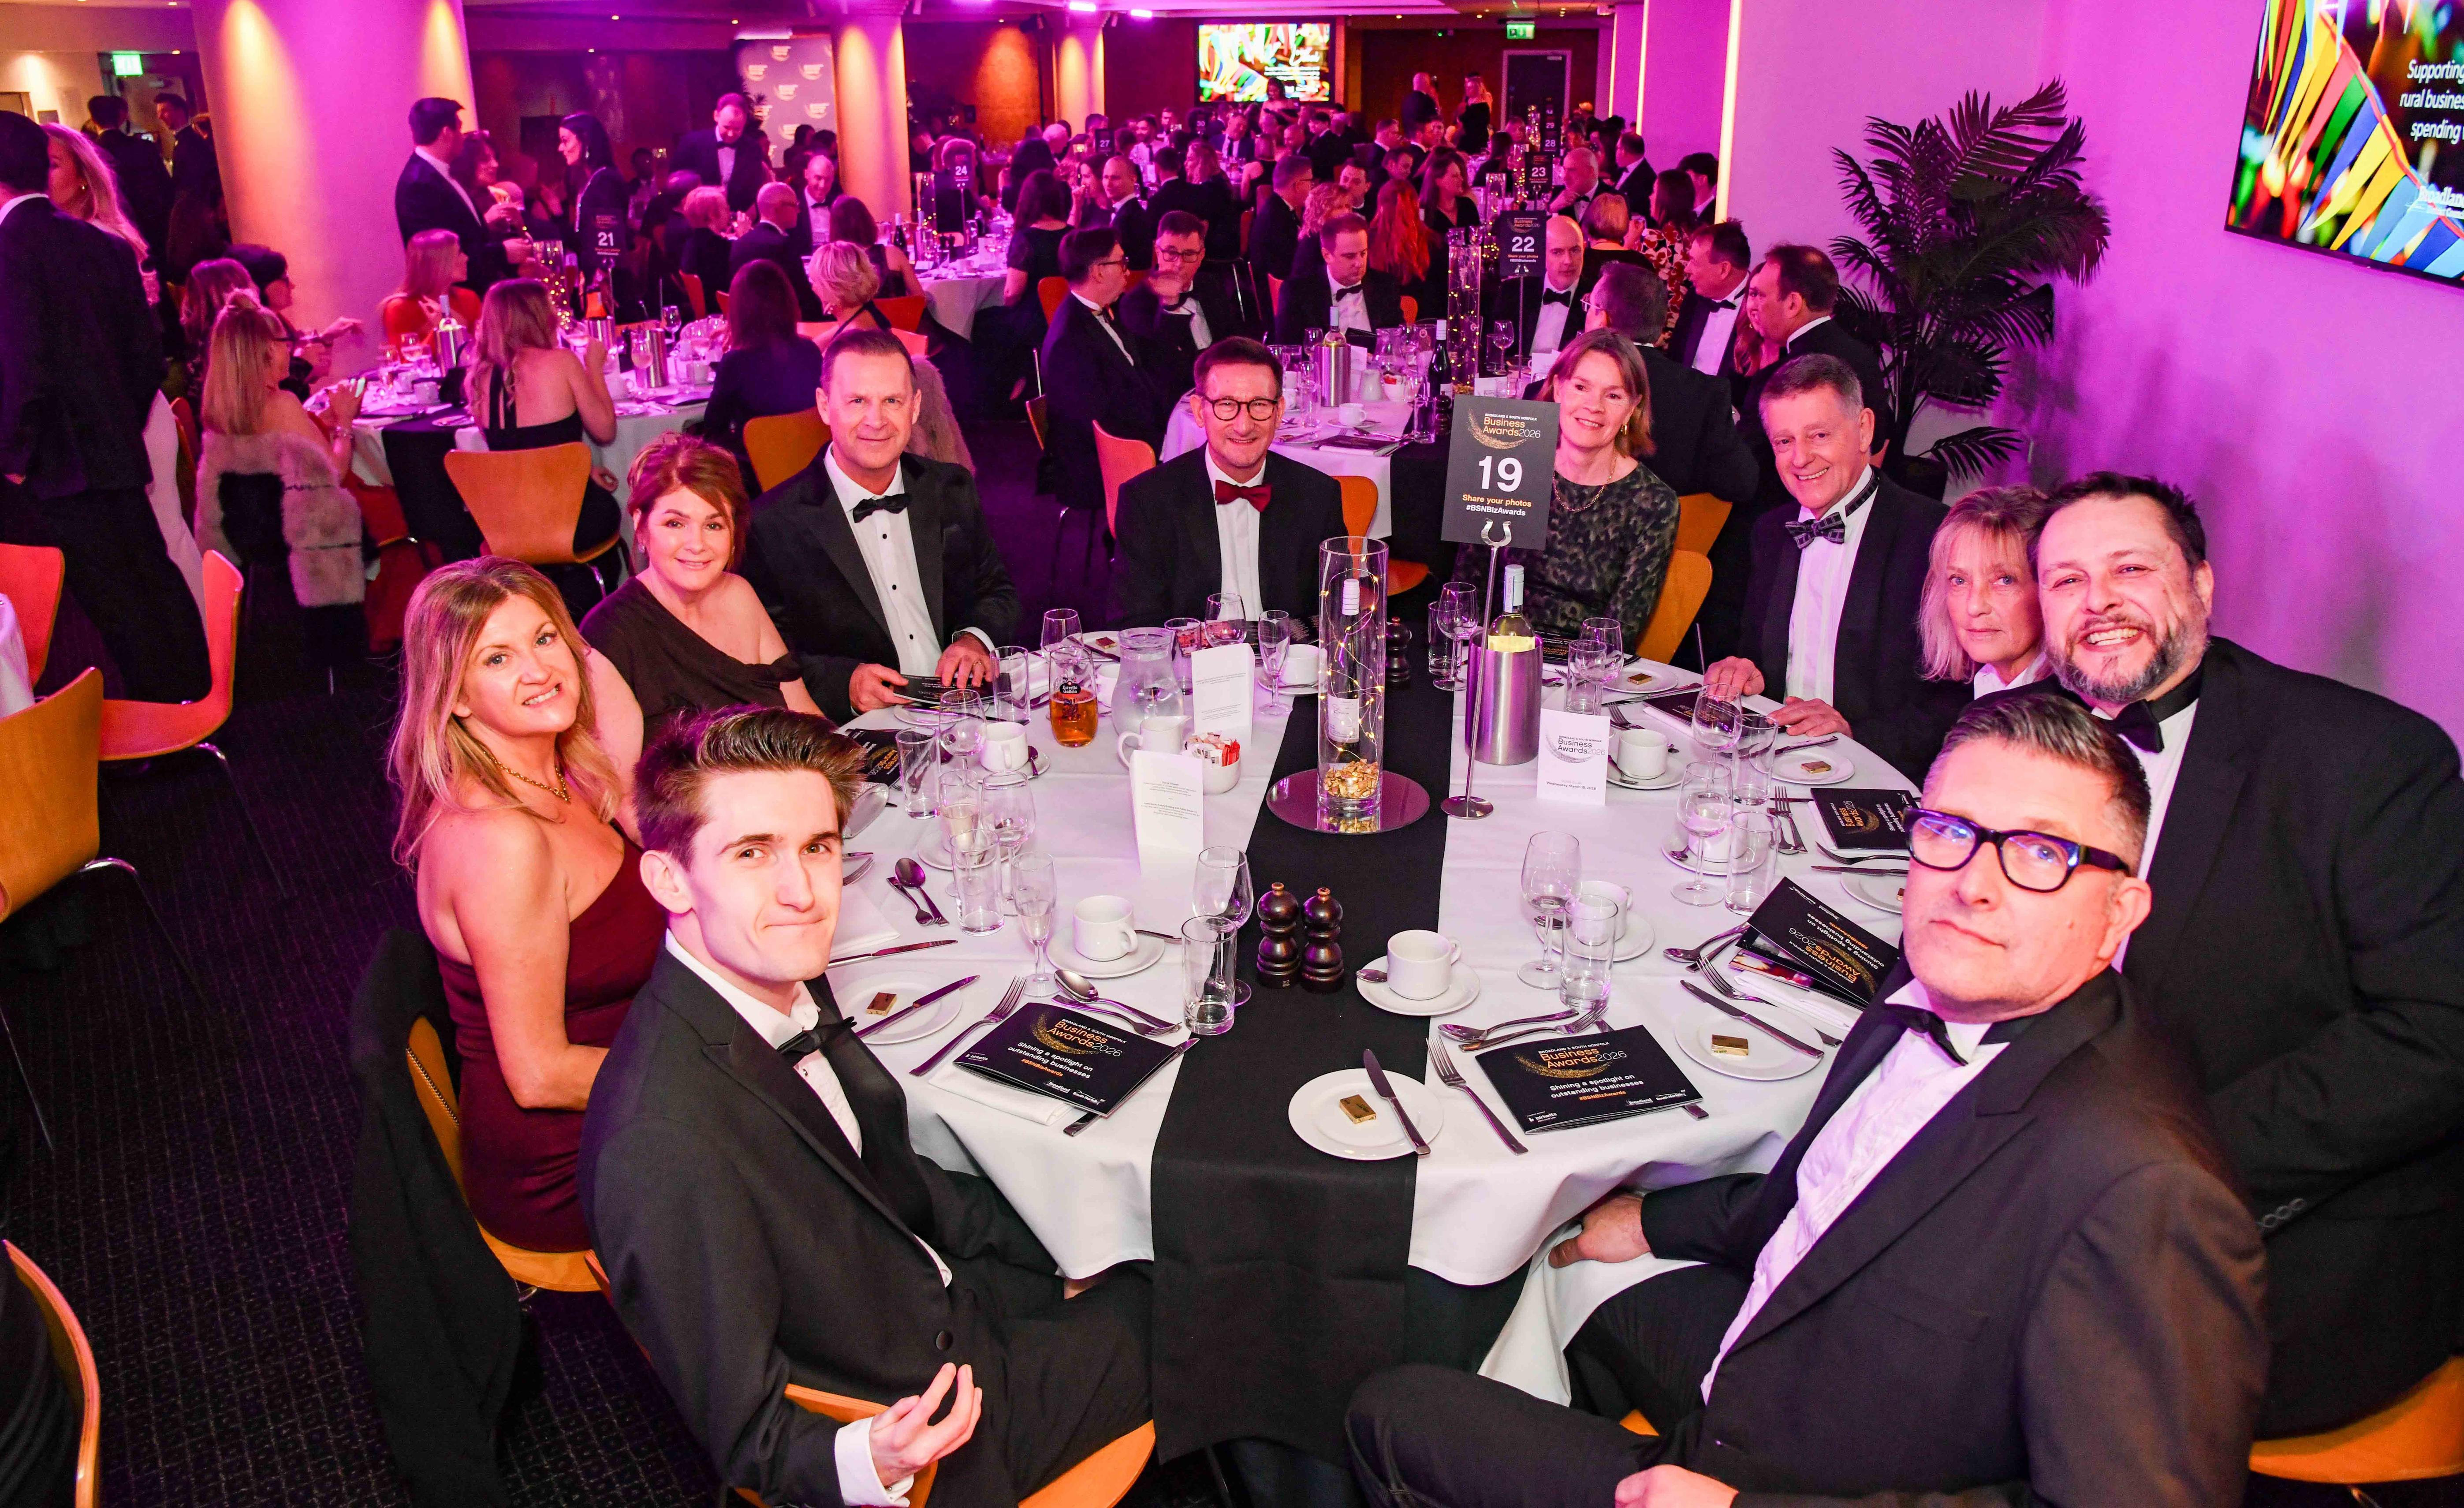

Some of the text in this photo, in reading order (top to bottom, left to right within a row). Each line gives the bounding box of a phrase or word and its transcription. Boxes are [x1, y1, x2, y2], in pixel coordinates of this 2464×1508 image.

[2407, 60, 2464, 84] Supporting
[2399, 89, 2426, 108] rural
[2410, 119, 2462, 145] spending
[955, 165, 968, 175] 24
[1532, 167, 1546, 177] 23
[598, 231, 614, 246] 21
[1512, 236, 1535, 252] 22
[1484, 417, 1525, 428] Business
[1479, 455, 1522, 492] 19
[1462, 494, 1485, 502] Share
[1505, 498, 1532, 507] photos
[1466, 504, 1526, 516] #BSNBizAwards
[1558, 738, 1592, 748] Business
[1839, 808, 1855, 827] Business
[1807, 913, 1885, 967] outstanding businesses
[1817, 926, 1845, 947] spotlight
[1789, 941, 1809, 956] NORFOLK
[1805, 946, 1857, 982] Business
[1809, 954, 1823, 965] SOUTH
[1853, 950, 1879, 970] Shining
[1054, 1021, 1108, 1043] Business
[1061, 1019, 1087, 1030] BROADLAND
[1106, 1034, 1127, 1044] NORFOLK
[1047, 1027, 1123, 1057] Awards2026
[1008, 1047, 1091, 1079] outstanding businesses
[1017, 1042, 1044, 1054] Shining
[1051, 1053, 1083, 1068] spotlight
[1540, 1048, 1599, 1061] Business
[1547, 1051, 1627, 1069] Awards2026
[1021, 1059, 1064, 1077] #BSNBizAwards
[1550, 1082, 1581, 1091] Shining
[1589, 1076, 1624, 1085] spotlight
[1551, 1080, 1644, 1098] outstanding businesses
[1579, 1090, 1626, 1101] #BSNBizAwards
